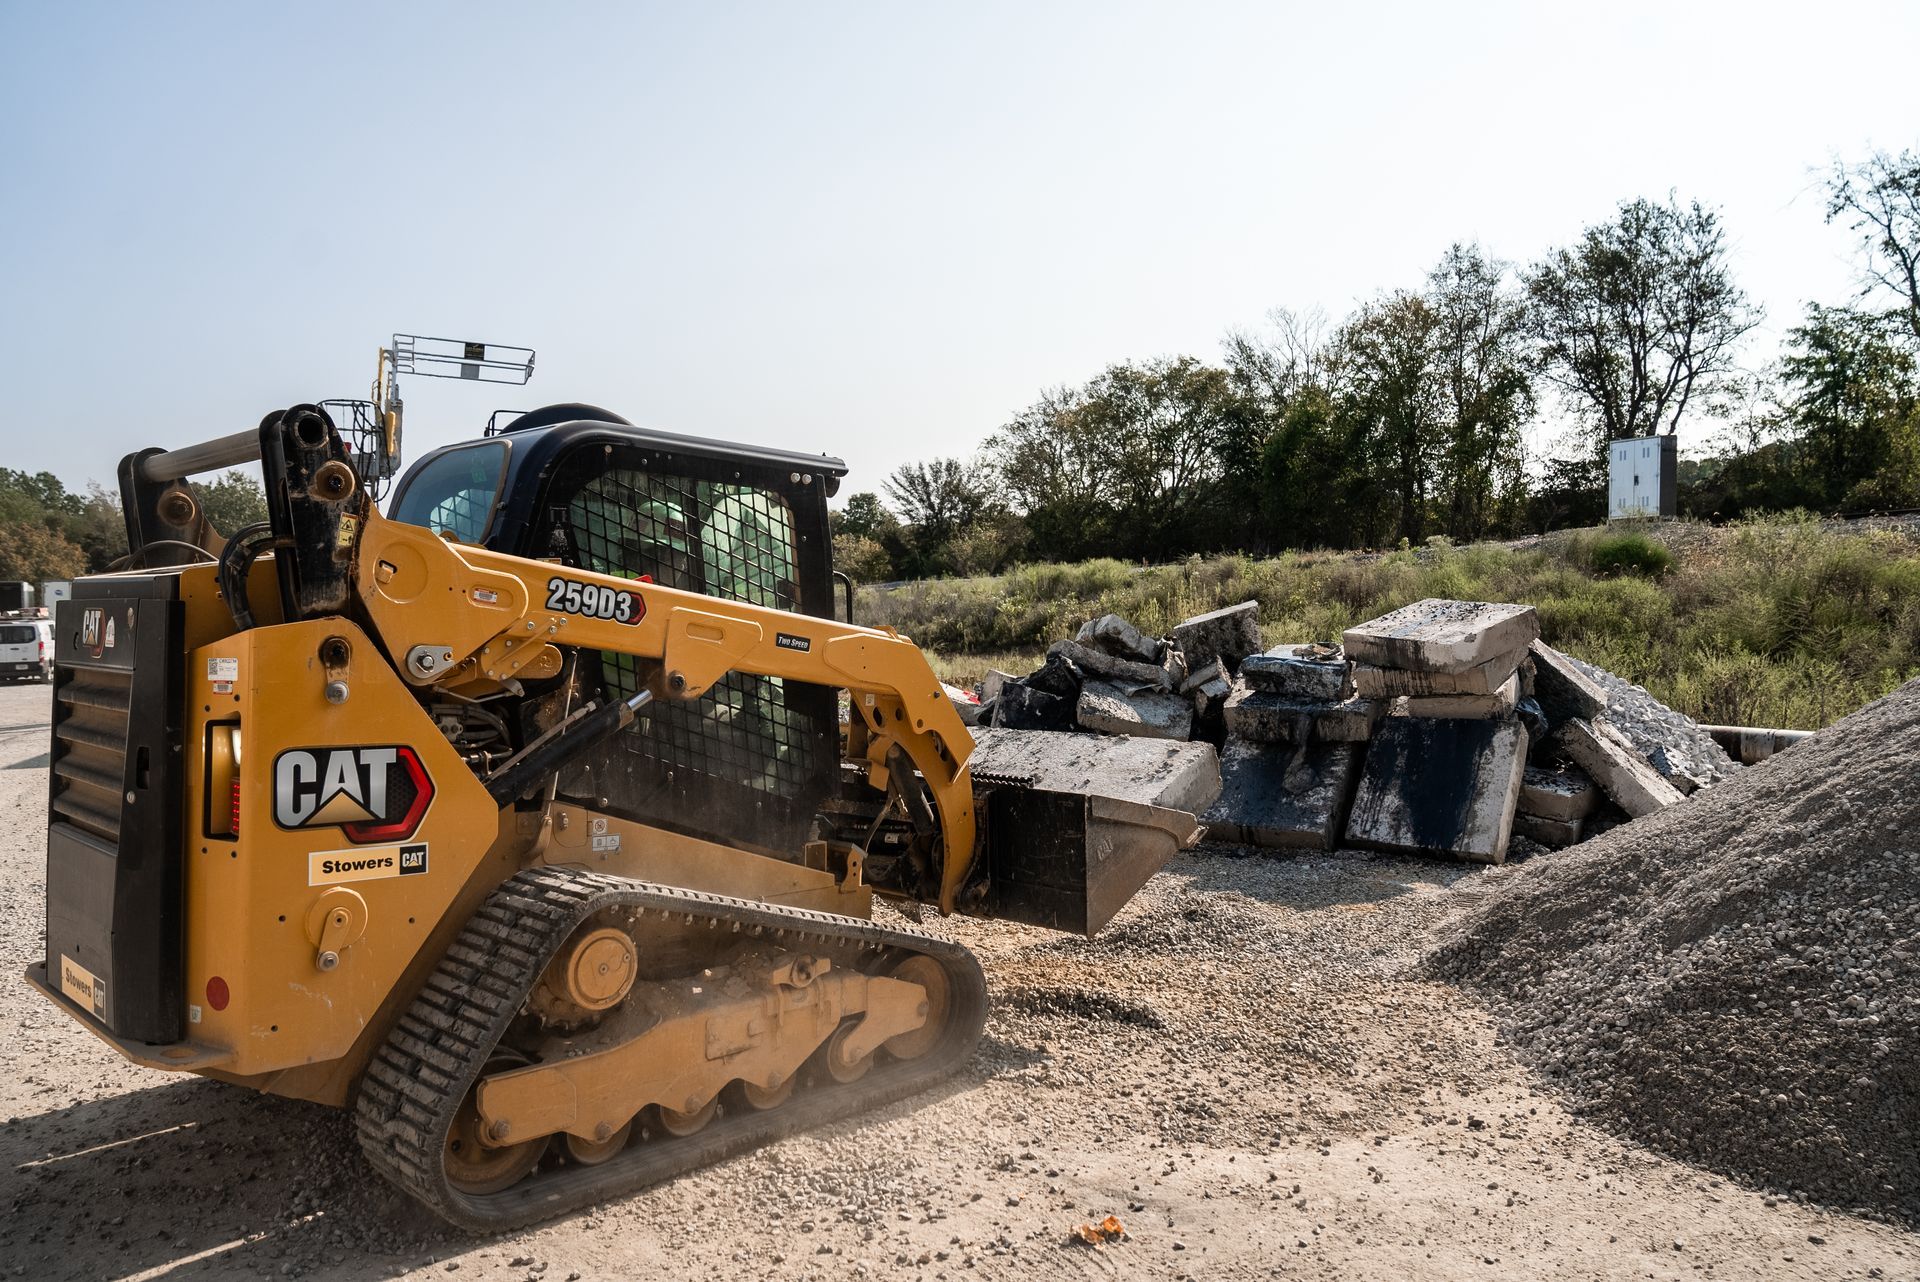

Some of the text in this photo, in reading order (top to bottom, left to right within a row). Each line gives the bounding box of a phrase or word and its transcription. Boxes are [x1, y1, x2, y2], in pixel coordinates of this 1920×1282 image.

[547, 578, 632, 622] 259D3
[83, 610, 101, 645] CAT
[276, 748, 397, 827] CAT
[322, 851, 425, 874] Stowers CAT
[66, 967, 92, 998] Stowers
